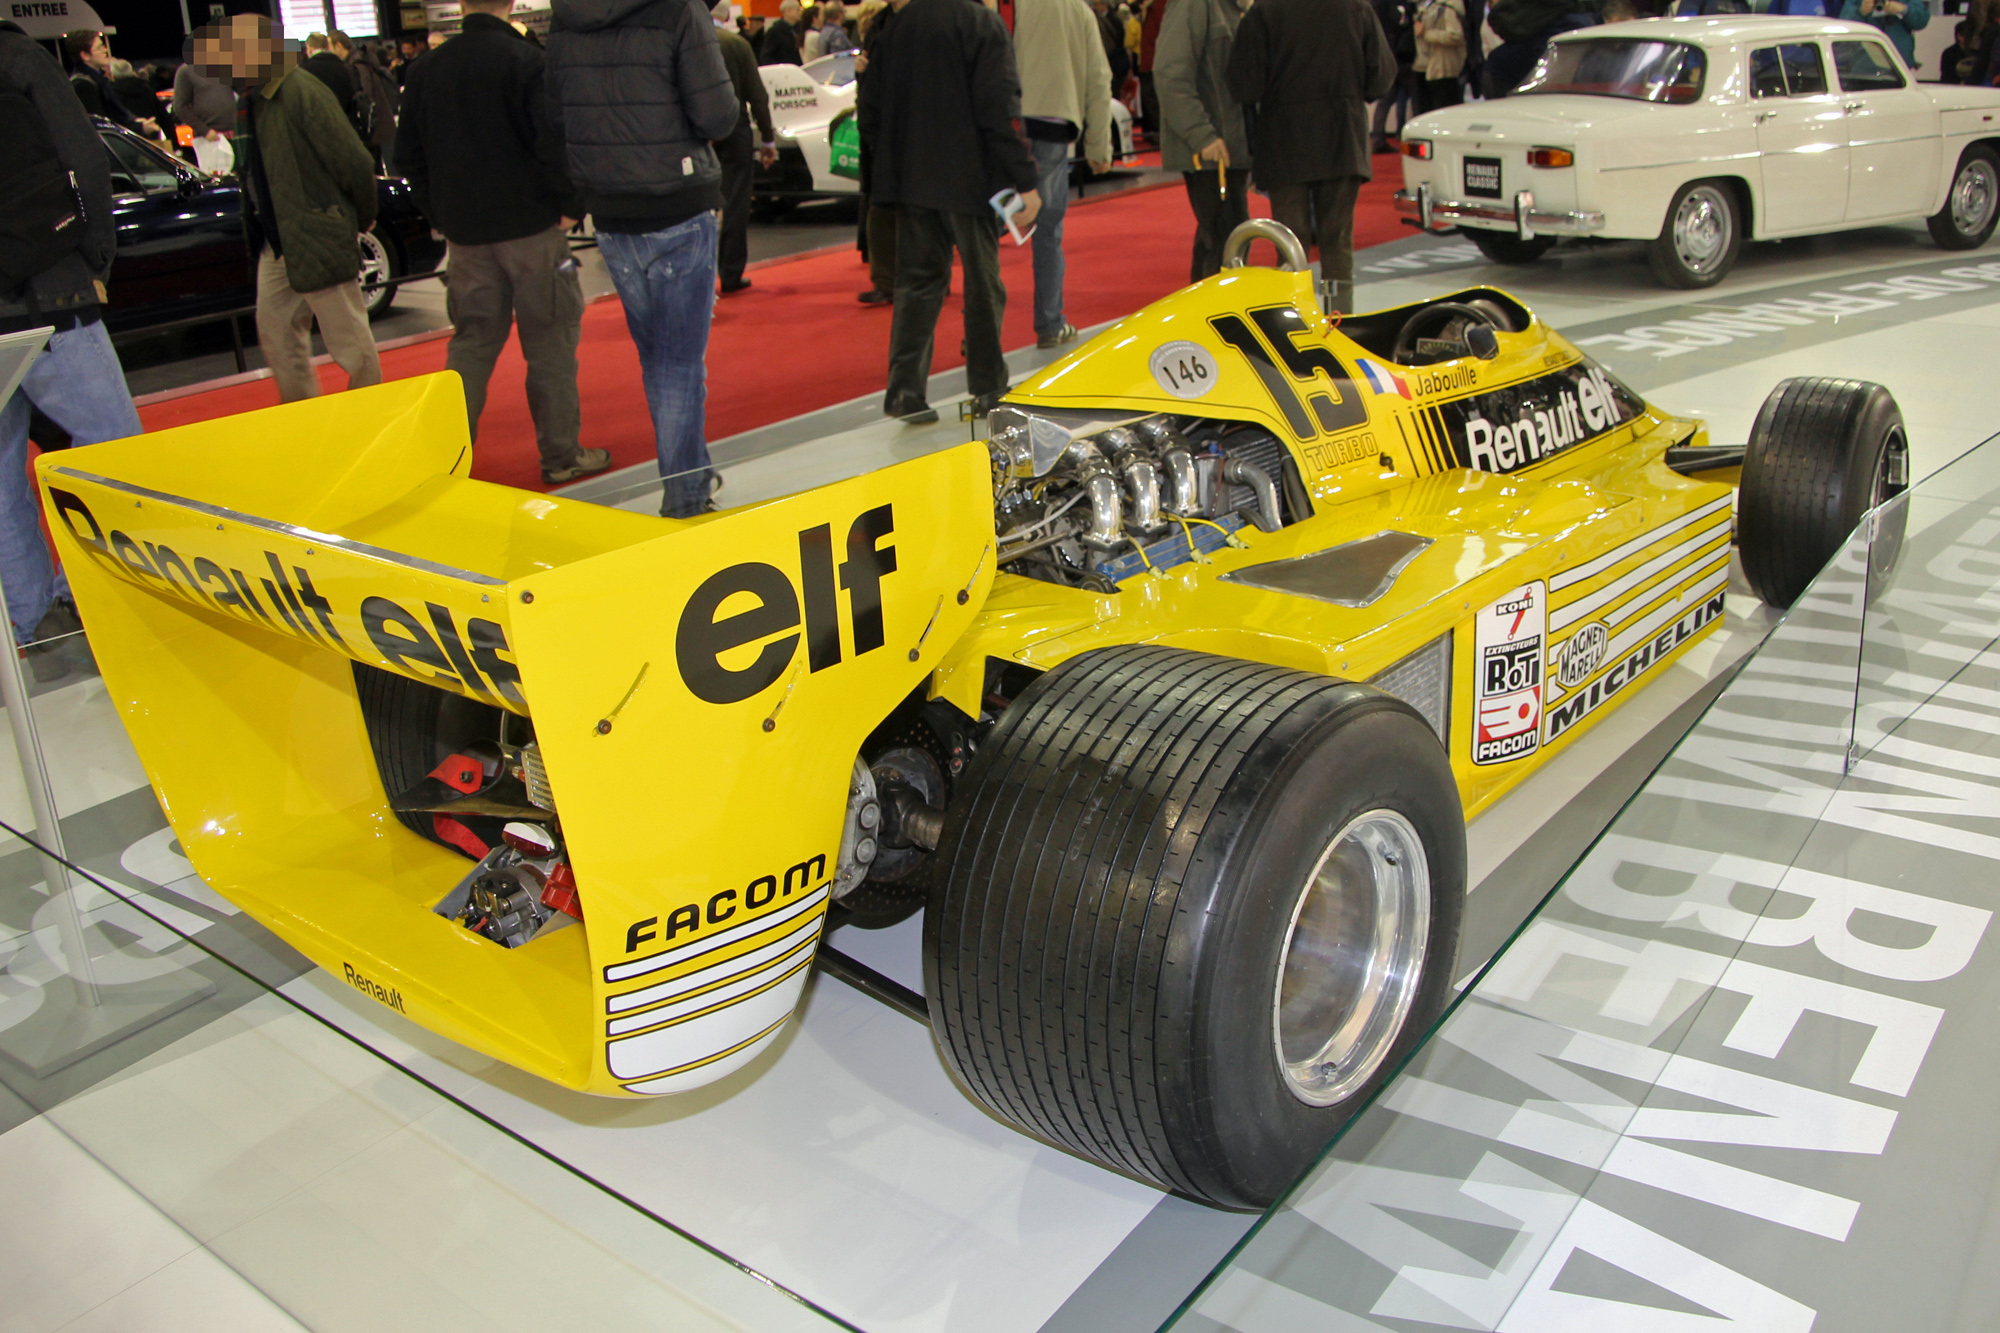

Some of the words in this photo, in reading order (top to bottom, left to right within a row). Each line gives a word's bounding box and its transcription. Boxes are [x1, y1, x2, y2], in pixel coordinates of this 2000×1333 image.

[11, 2, 69, 18] ENTREE
[773, 97, 818, 110] PORSCHE
[774, 86, 815, 97] MARTINI
[1163, 355, 1207, 389] 146
[1207, 303, 1369, 442] 15
[1415, 366, 1478, 397] Jabouille
[1465, 390, 1585, 474] Renault
[1578, 366, 1622, 431] elf
[1304, 432, 1379, 471] TURBO
[49, 486, 366, 660] Renault
[676, 503, 897, 704] elf
[1497, 598, 1533, 615] KONI
[1486, 636, 1539, 656] EXTINCTEURS
[1551, 591, 1726, 737] MICHELIN
[1560, 626, 1606, 671] MAGNETI
[1479, 730, 1537, 760] FACOM
[626, 853, 826, 953] FACOM
[343, 961, 406, 1014] Renault
